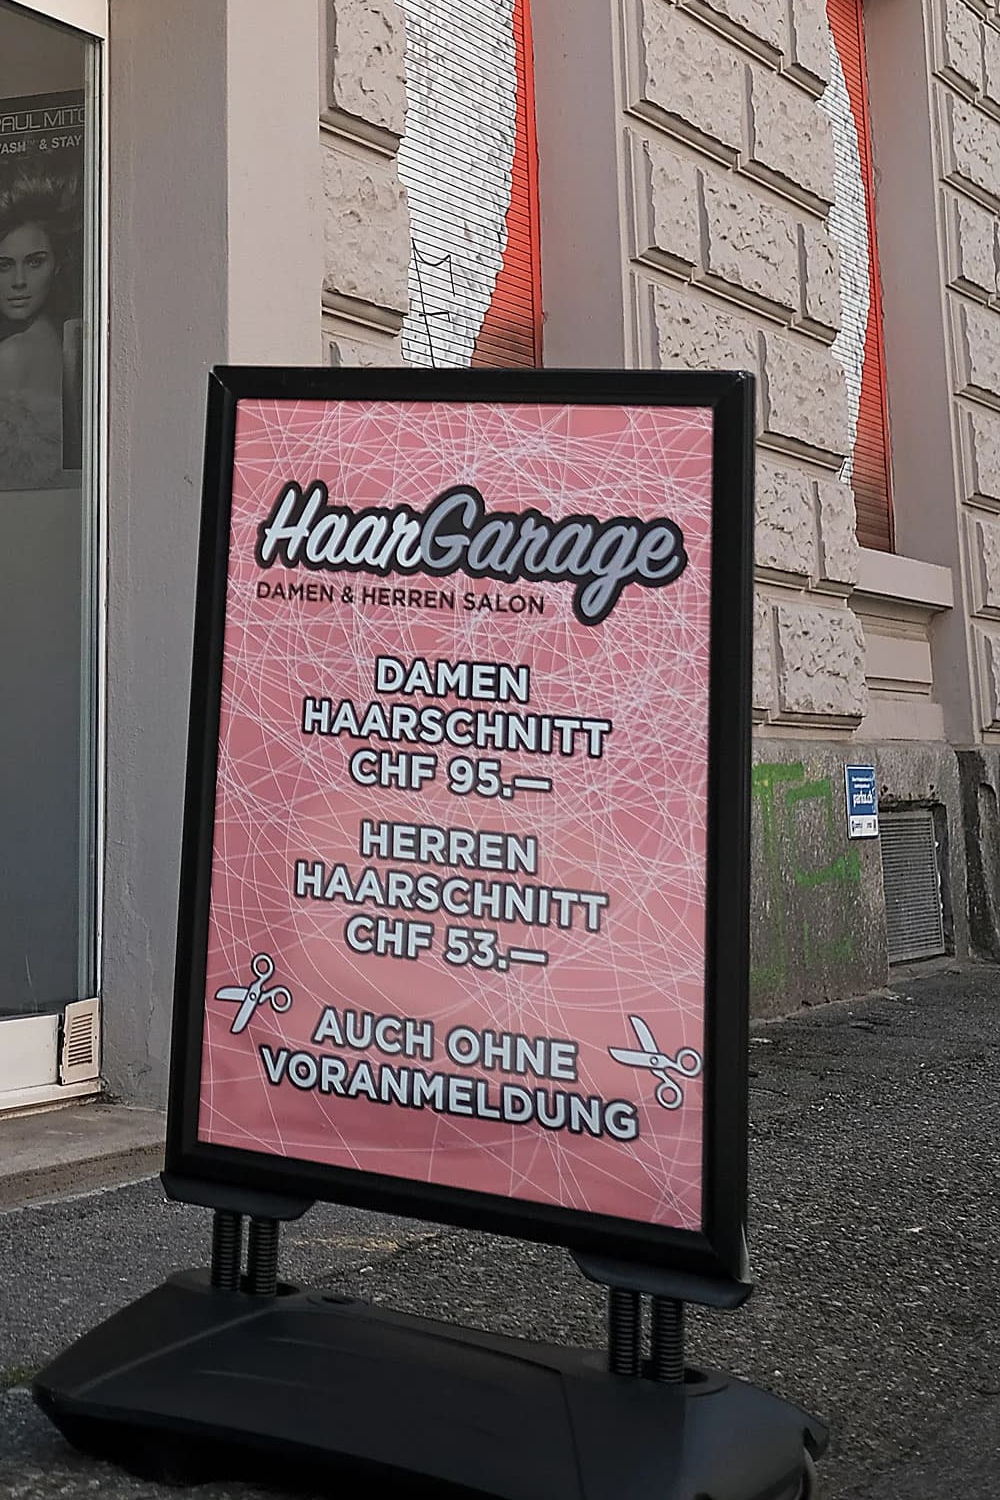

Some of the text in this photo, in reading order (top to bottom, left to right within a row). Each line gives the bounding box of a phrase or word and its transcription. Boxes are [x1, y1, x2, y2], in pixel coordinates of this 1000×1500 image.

[39, 138, 48, 150] &
[51, 135, 82, 149] STAY
[258, 483, 684, 621] HaarGarage
[256, 581, 546, 615] DAMEN & HERREN SALON
[376, 656, 530, 702] DAMEN
[302, 699, 612, 758] HAARSCHNITT
[349, 751, 437, 790] CHF
[360, 820, 538, 874] HERREN
[295, 860, 610, 931] HAARSCHNITT
[345, 916, 433, 959] CHF
[312, 1006, 578, 1082] AUCH OHNE
[259, 1046, 640, 1141] VORANMELDUNG
